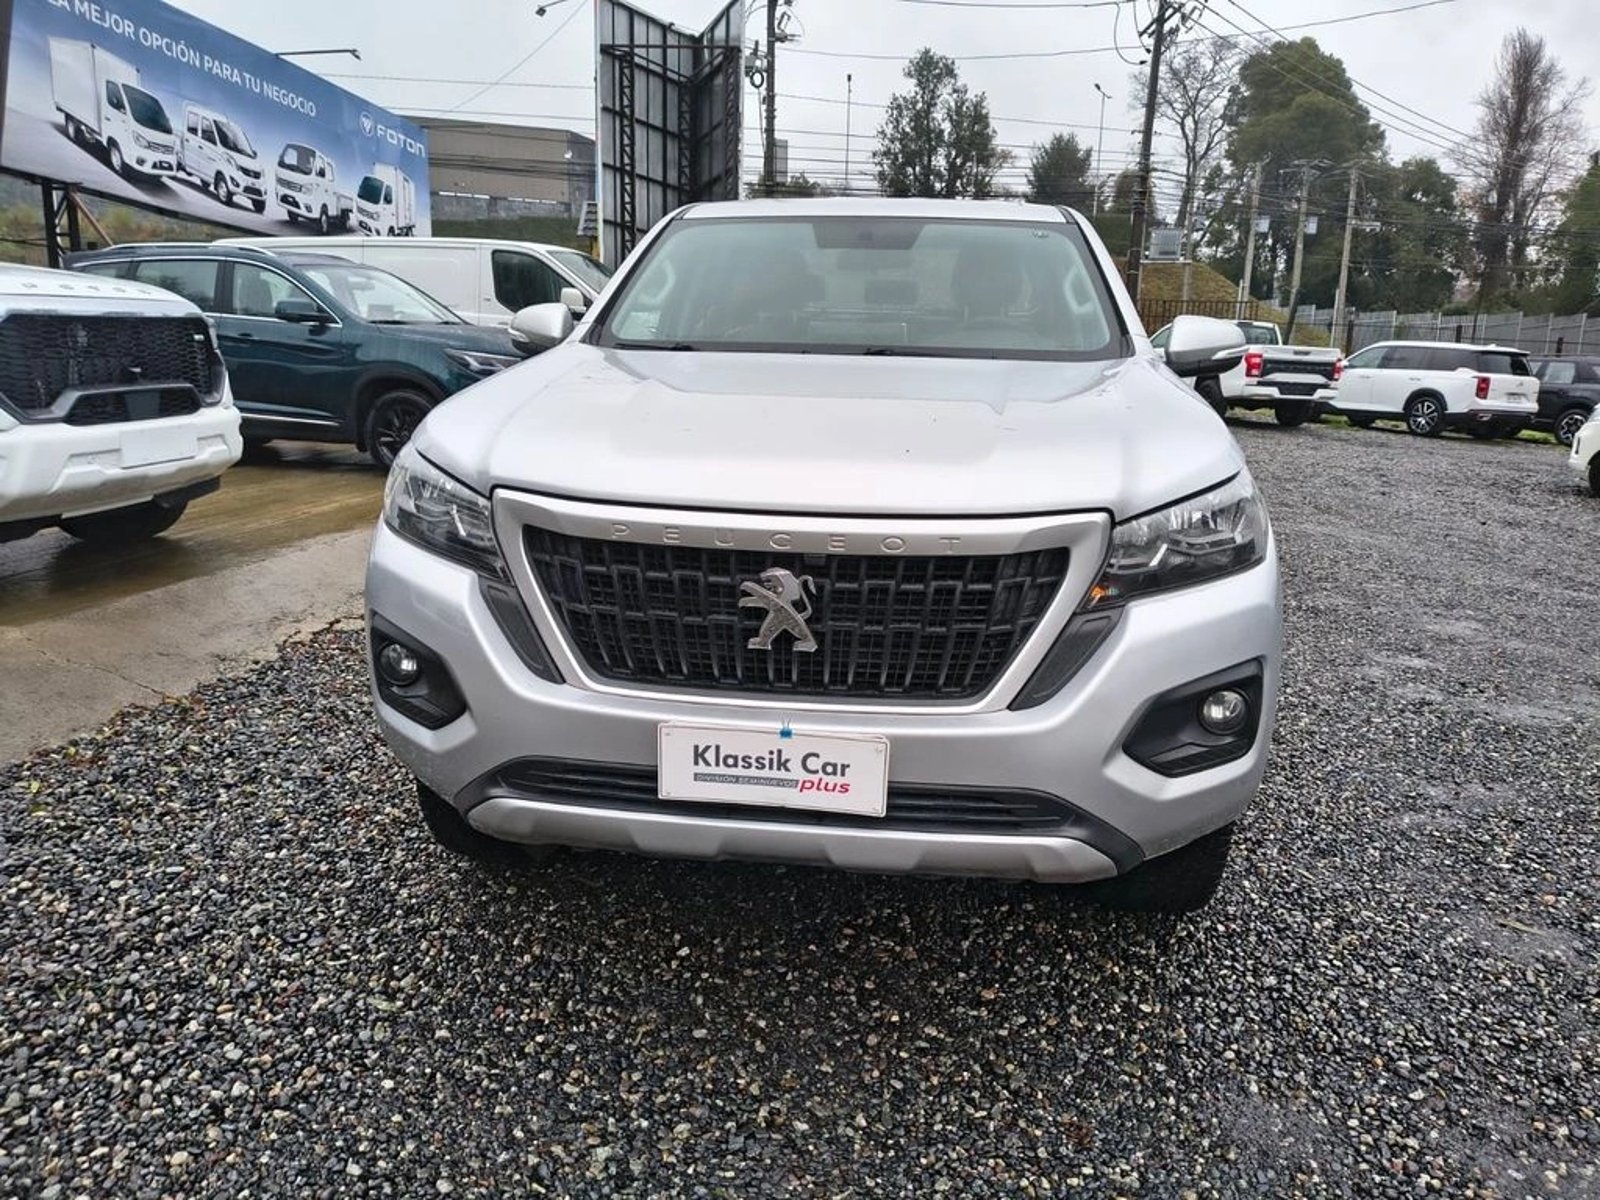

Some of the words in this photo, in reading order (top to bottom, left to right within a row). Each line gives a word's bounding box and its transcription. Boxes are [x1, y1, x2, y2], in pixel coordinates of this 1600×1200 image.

[74, 0, 136, 41] MEJOR
[138, 28, 200, 67] OPCIÓN
[204, 55, 241, 85] PARA
[242, 72, 261, 94] TU
[263, 83, 316, 118] NEGOCIO
[376, 124, 425, 157] FOTON
[611, 523, 961, 553] PEUGEOT
[693, 744, 791, 773] Klassik
[801, 752, 851, 777] Car
[798, 776, 851, 794] plus
